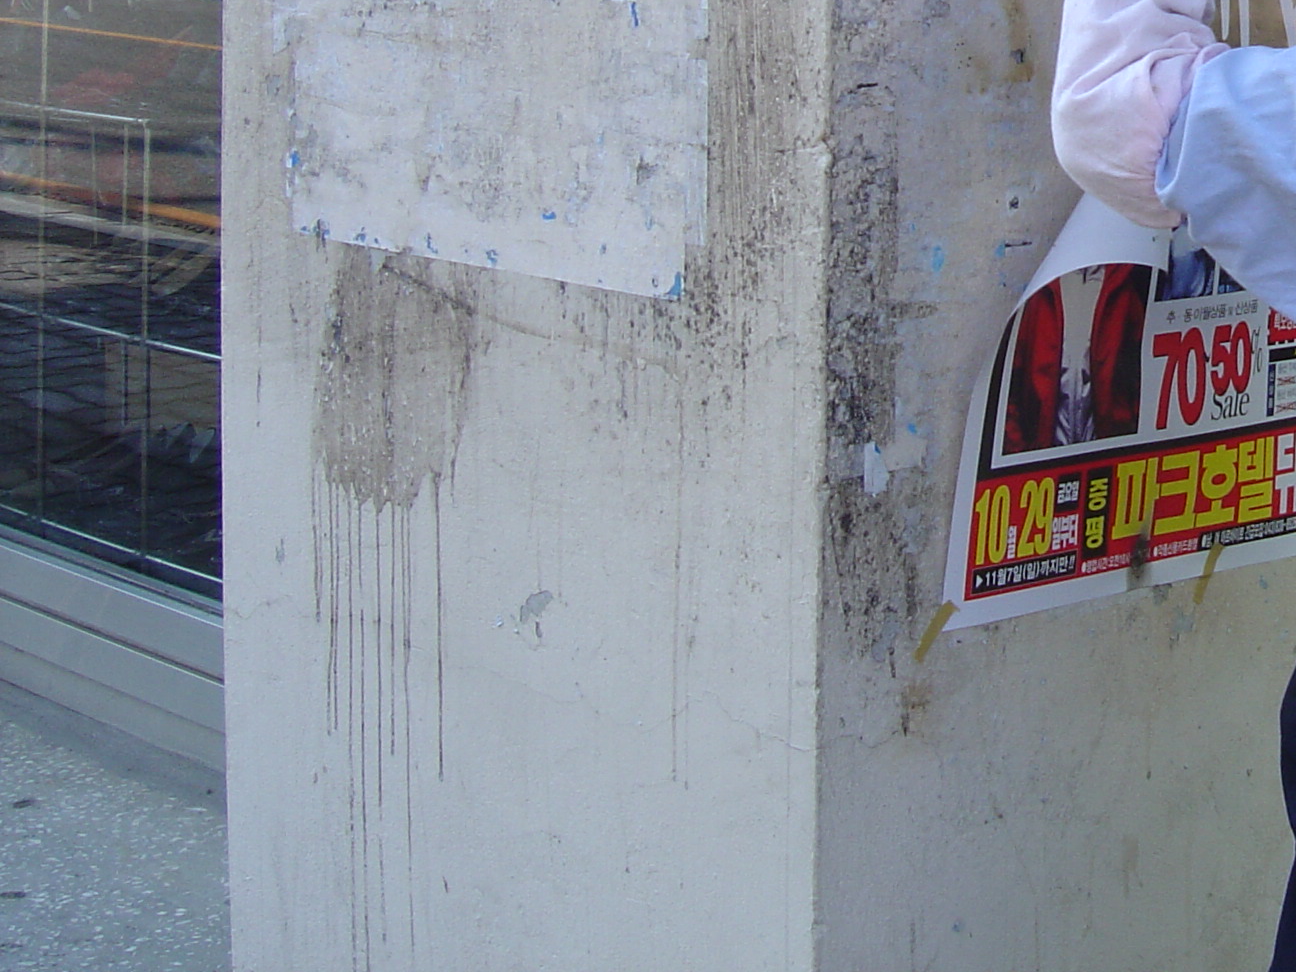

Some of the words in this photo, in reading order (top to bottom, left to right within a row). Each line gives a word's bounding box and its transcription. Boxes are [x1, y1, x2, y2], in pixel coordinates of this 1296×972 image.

[1210, 392, 1250, 421] Sale
[1057, 480, 1080, 504] 금요일
[1111, 435, 1275, 541] 파크호텔
